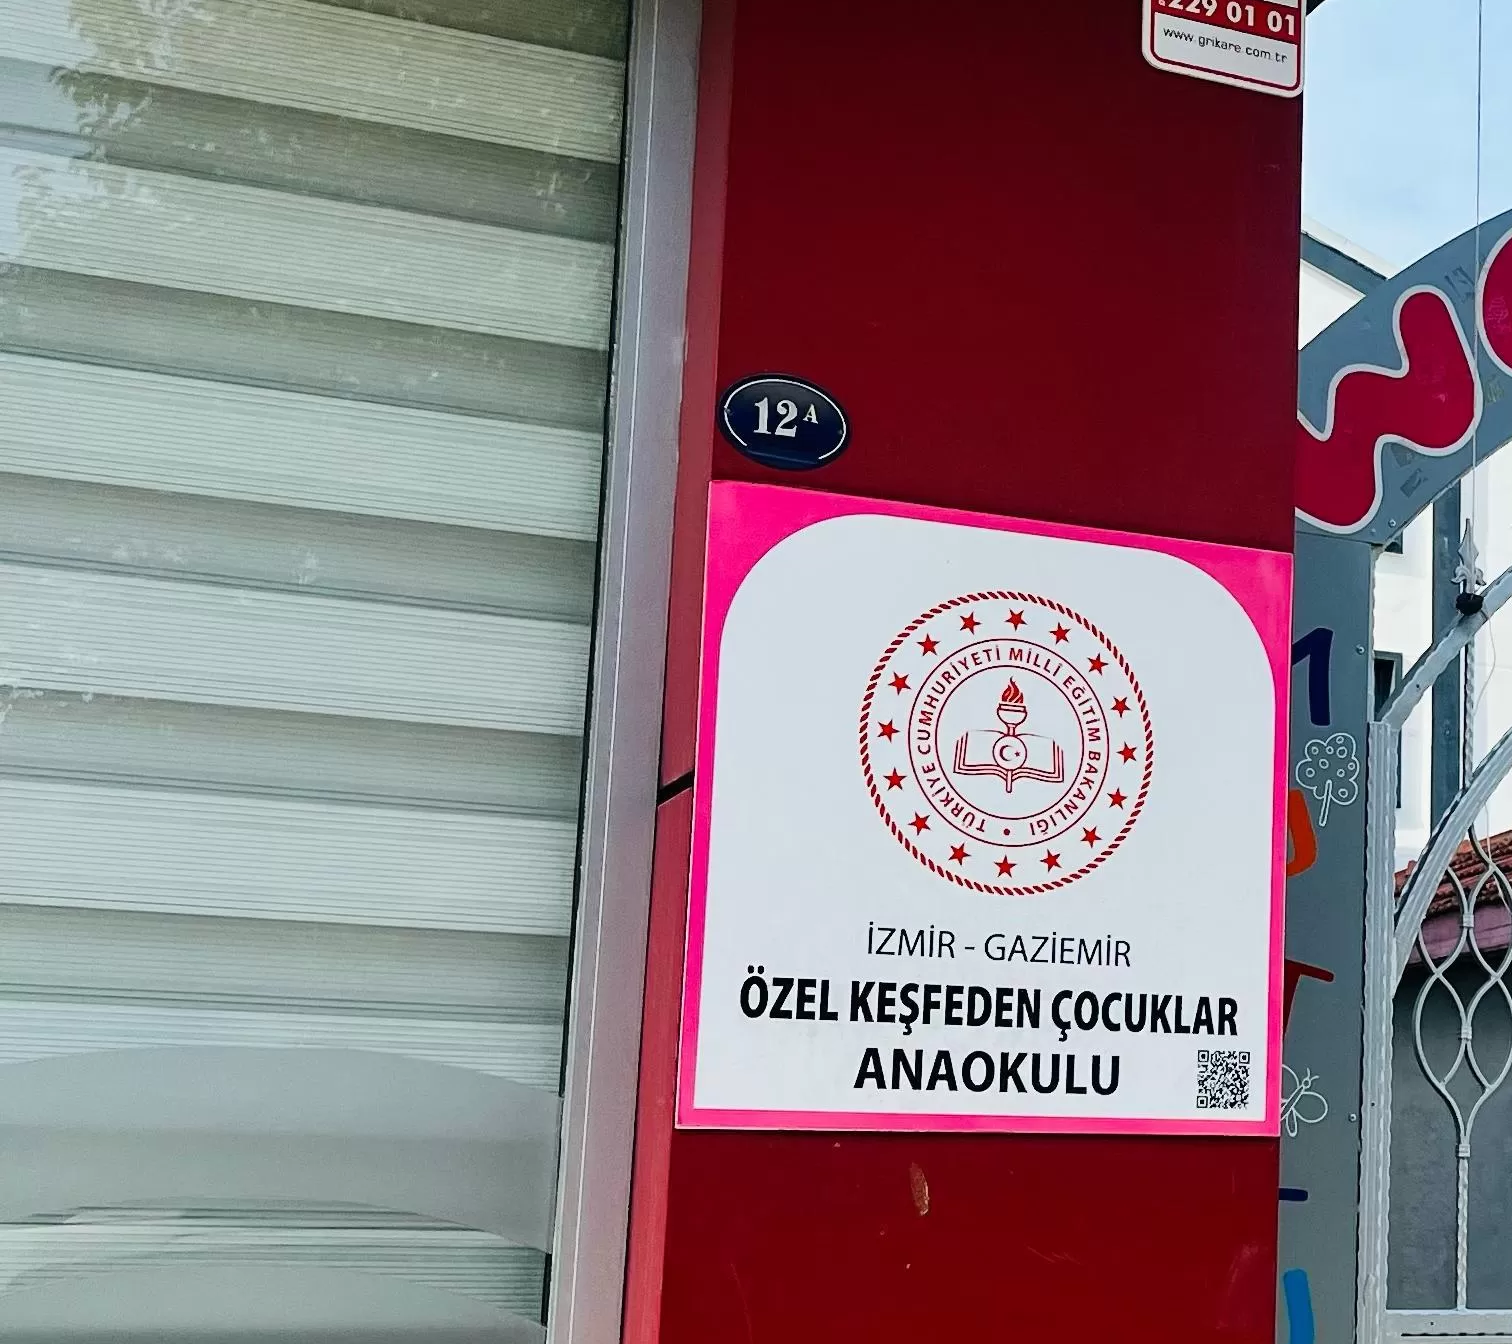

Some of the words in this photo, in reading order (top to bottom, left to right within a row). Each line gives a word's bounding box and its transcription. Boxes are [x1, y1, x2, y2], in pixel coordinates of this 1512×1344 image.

[1226, 0, 1255, 27] 01
[1266, 10, 1295, 36] 01
[917, 644, 1001, 756] CUMHURİYETİ
[1062, 675, 1101, 743] EĞİTİM
[921, 762, 986, 833] TÜRKİYE
[1029, 750, 1101, 836] BAKANLIĞI
[867, 920, 956, 959] İZMİR
[984, 932, 1131, 968] GAZİEMİR
[740, 965, 839, 1022] ÖZEL
[849, 980, 1041, 1036] KEŞFEDEN
[1051, 989, 1239, 1042] ÇOCUKLAR
[853, 1047, 1121, 1097] ANAOKULU
